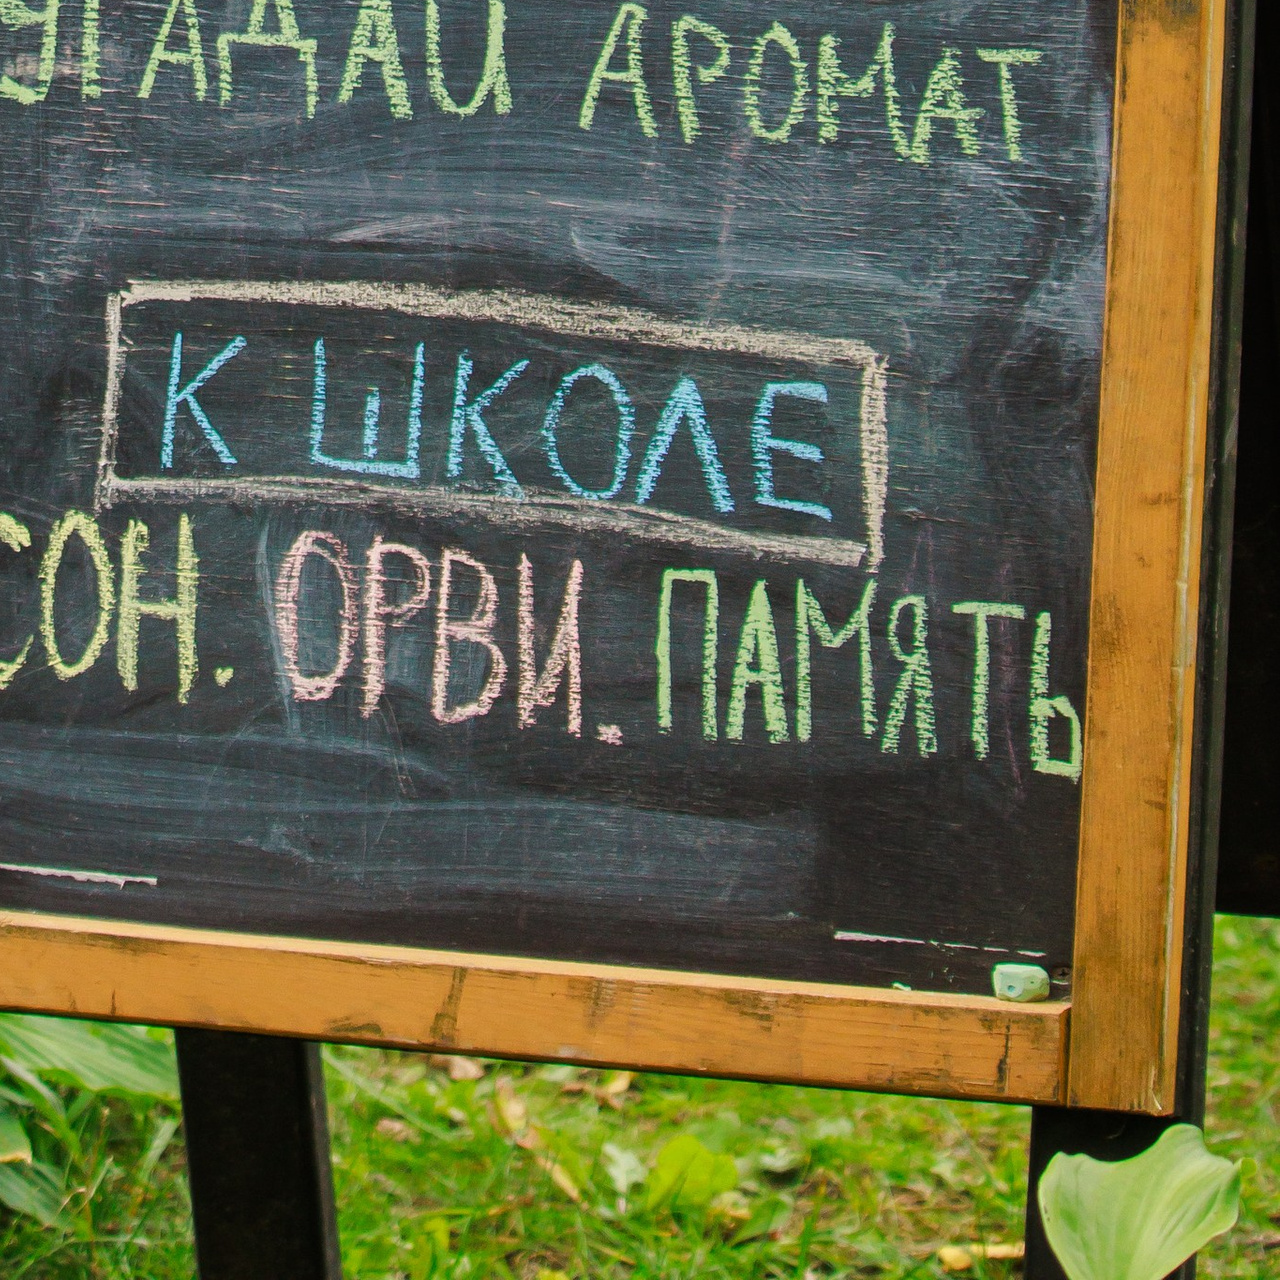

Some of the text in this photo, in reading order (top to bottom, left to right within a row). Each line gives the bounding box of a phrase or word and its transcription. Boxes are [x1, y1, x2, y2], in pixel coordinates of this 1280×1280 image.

[579, 1, 1042, 164] АРОМАТ
[160, 330, 833, 522] К ШКОЛЕ
[275, 529, 622, 746] ОРВИ.
[655, 567, 1084, 784] ПАМЯТЬ
